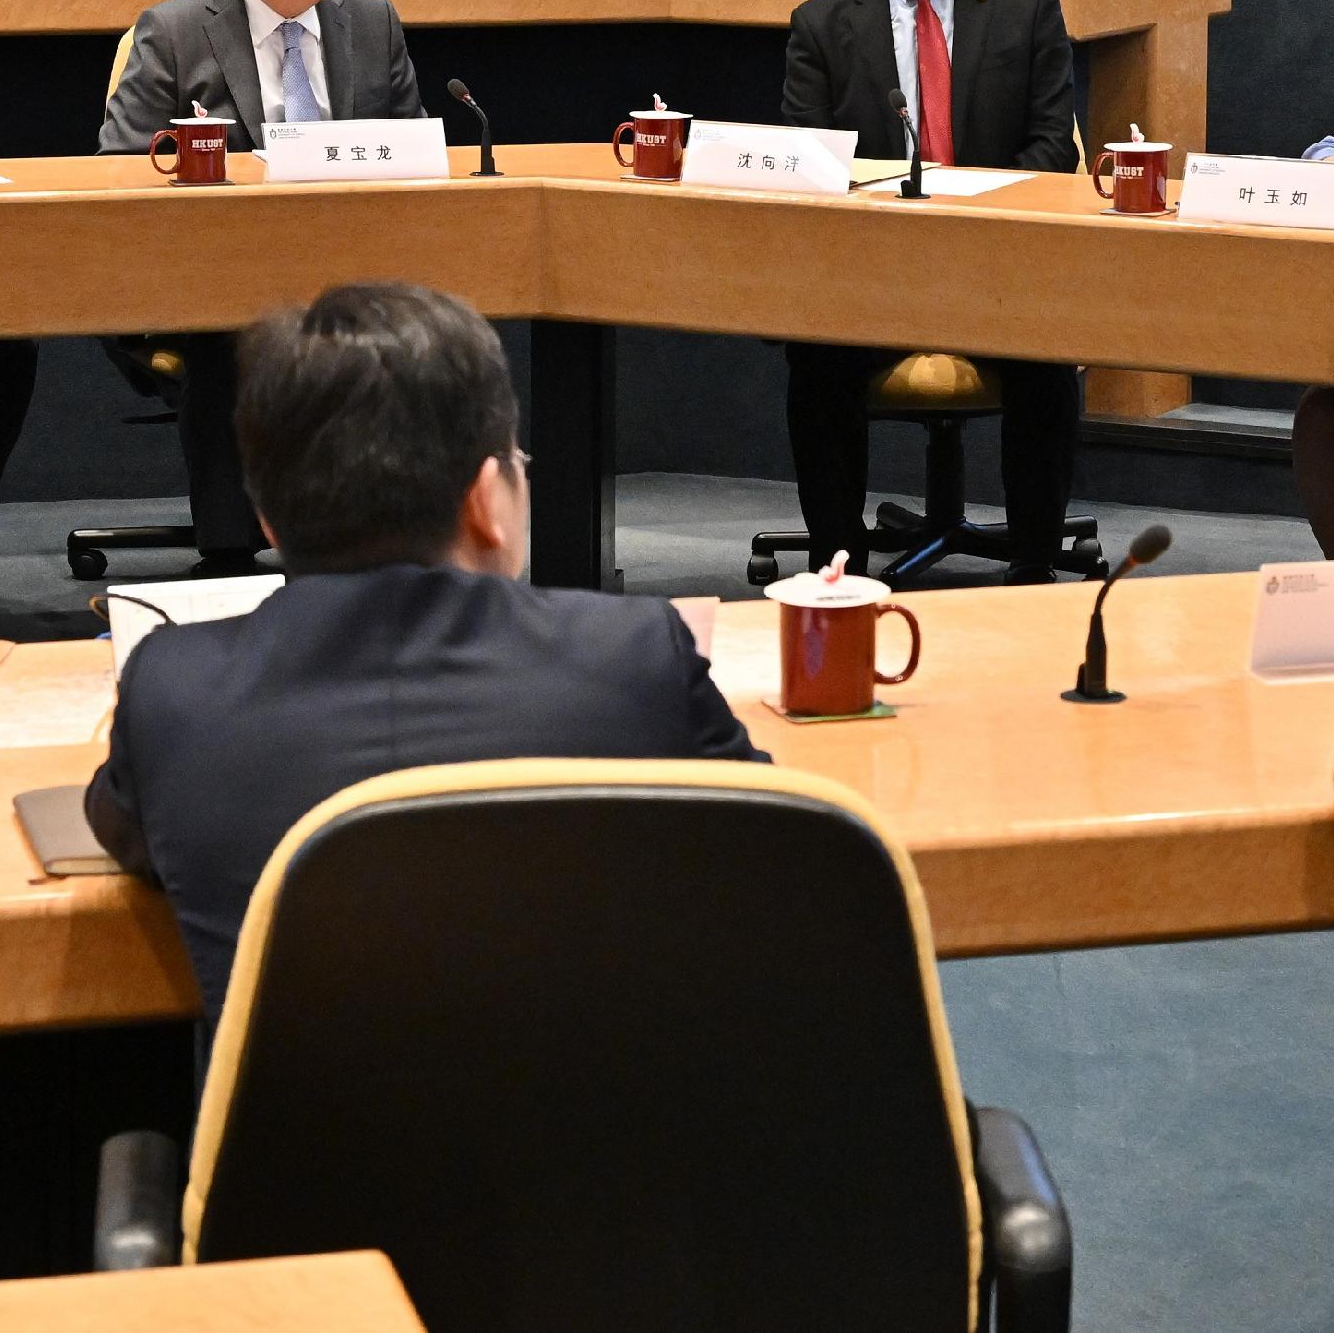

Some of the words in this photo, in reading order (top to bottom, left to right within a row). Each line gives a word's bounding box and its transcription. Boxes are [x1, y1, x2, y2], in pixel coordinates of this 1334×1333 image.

[191, 138, 224, 149] HKUST
[324, 145, 392, 162] 夏宝龙
[737, 152, 800, 173] 沈向洋
[1239, 186, 1308, 206] 叶玉如
